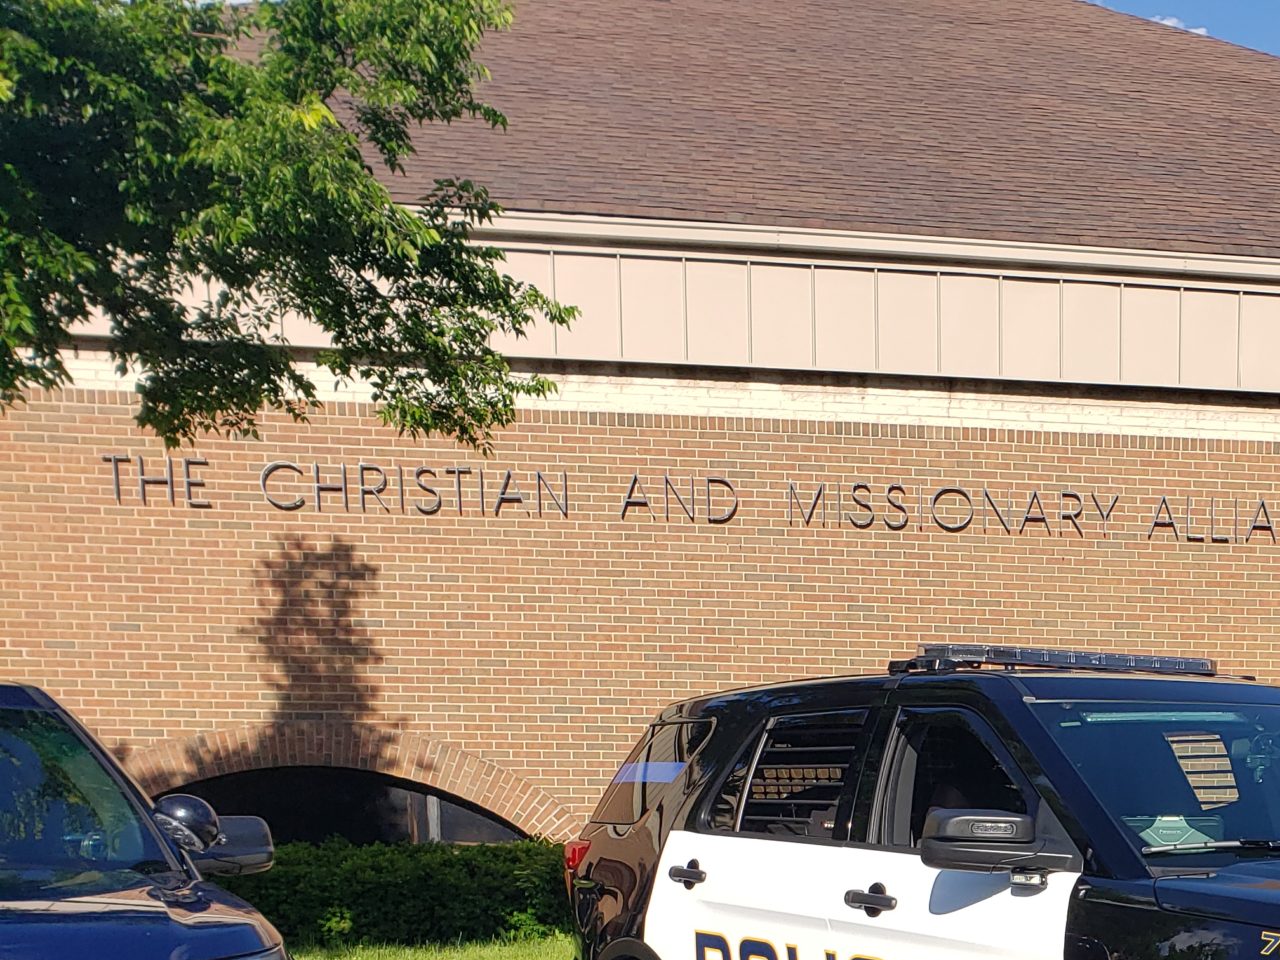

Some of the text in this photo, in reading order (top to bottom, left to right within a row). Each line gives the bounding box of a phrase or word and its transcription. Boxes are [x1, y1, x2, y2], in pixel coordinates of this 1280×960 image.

[102, 455, 213, 510] THE
[260, 460, 570, 520] CHRISTIAN
[620, 473, 739, 525] AND
[788, 481, 1119, 538] MISSIONARY
